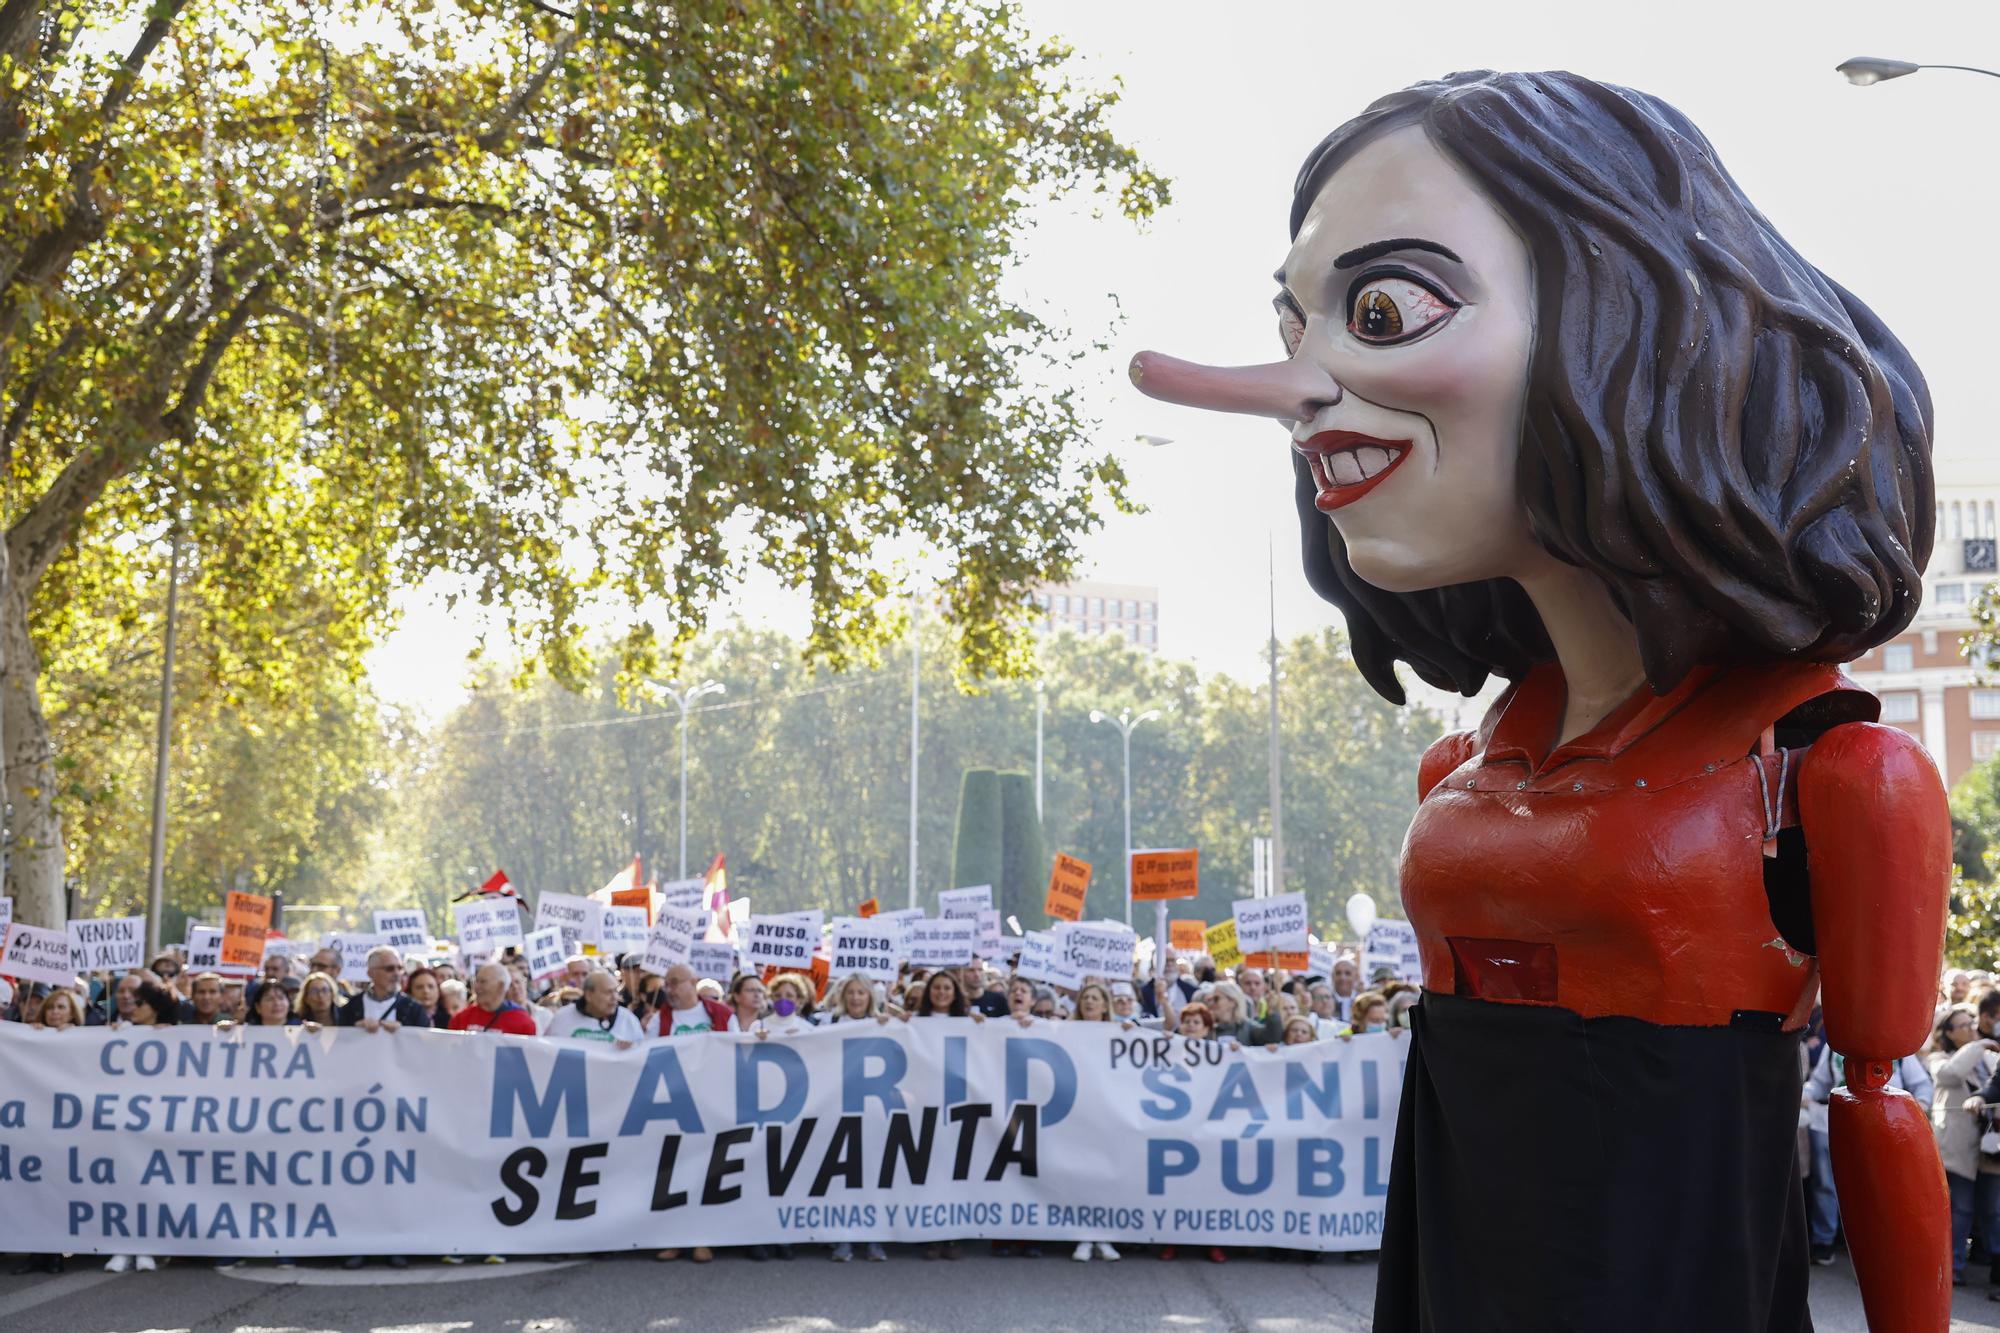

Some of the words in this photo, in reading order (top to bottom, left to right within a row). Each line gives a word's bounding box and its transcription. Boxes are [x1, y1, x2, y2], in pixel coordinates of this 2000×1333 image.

[542, 903, 586, 922] FASCISMO
[1240, 911, 1261, 924] Con
[1264, 904, 1302, 919] AYUSO
[76, 922, 133, 943] VENDEN
[755, 924, 809, 942] AYUSO.
[751, 942, 808, 959] ABUSO.
[838, 937, 894, 953] AYUSO.
[8, 950, 28, 965] MIL
[193, 954, 216, 966] NOS
[835, 956, 894, 971] ABUSO.
[100, 1039, 316, 1080] CONTRA
[1111, 1038, 1171, 1069] POR
[1184, 1038, 1223, 1067] SU
[490, 1036, 1078, 1138] MADRID
[52, 1083, 429, 1133] DESTRUCCIÓN
[68, 1146, 115, 1185] la
[140, 1136, 417, 1186] ATENCIÓN
[491, 1142, 609, 1227] SE
[650, 1103, 1039, 1212] LEVANTA
[68, 1200, 338, 1239] PRIMARIA
[777, 1204, 876, 1229] VECINAS
[886, 1204, 899, 1227] Y
[905, 1202, 1002, 1228] VECINOS
[1011, 1203, 1039, 1226] DE
[1048, 1204, 1144, 1230] BARRIOS
[1153, 1209, 1168, 1230] Y
[1174, 1208, 1274, 1233] PUEBLOS
[1284, 1211, 1311, 1235] DE
